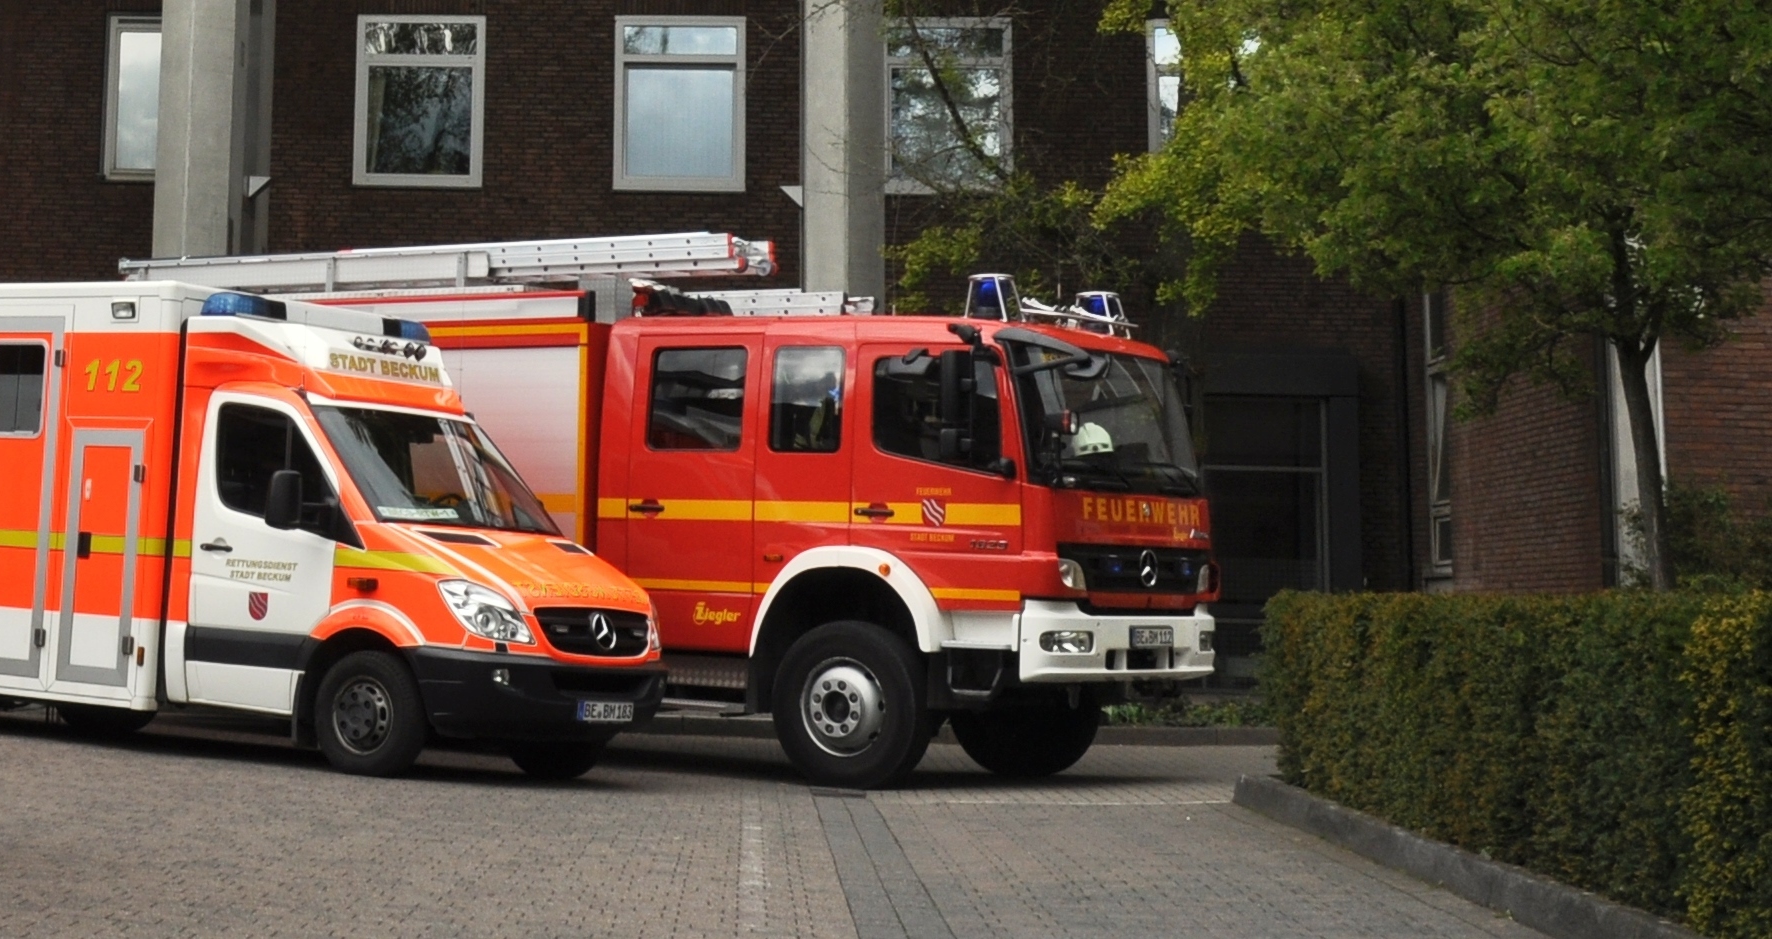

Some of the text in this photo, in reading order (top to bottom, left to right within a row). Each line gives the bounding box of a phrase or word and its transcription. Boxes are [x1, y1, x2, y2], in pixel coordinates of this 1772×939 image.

[85, 358, 143, 392] 112
[329, 353, 440, 382] STADT BECKUM
[916, 487, 952, 496] FEUERWEHR
[1083, 496, 1200, 526] FEUERWEHR
[226, 559, 298, 571] RETTUNGSDIENST
[230, 570, 291, 582] STADT BECKUM
[693, 601, 742, 625] Ziegler
[584, 703, 633, 719] BE BM 183
